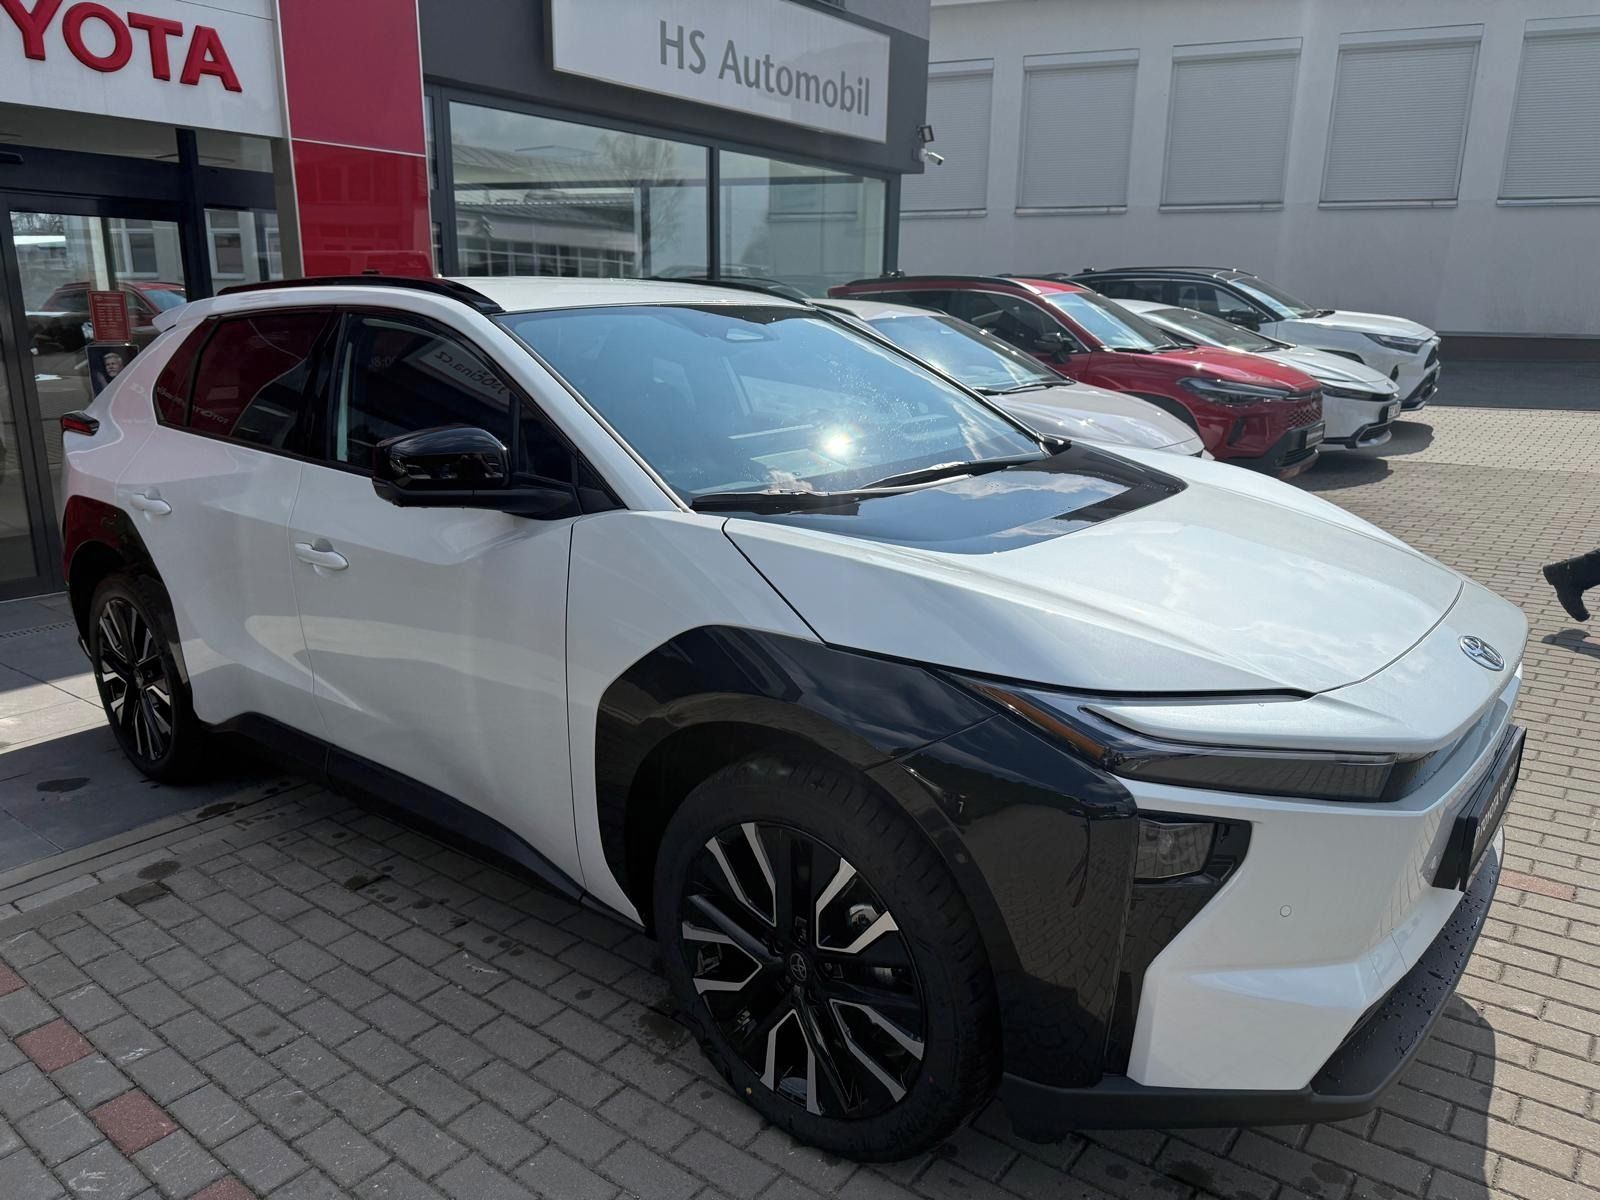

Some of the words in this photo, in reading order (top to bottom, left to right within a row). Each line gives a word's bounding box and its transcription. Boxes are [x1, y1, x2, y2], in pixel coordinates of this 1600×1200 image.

[0, 0, 242, 93] YOTA
[659, 20, 706, 74] HS
[718, 39, 870, 116] Automobil
